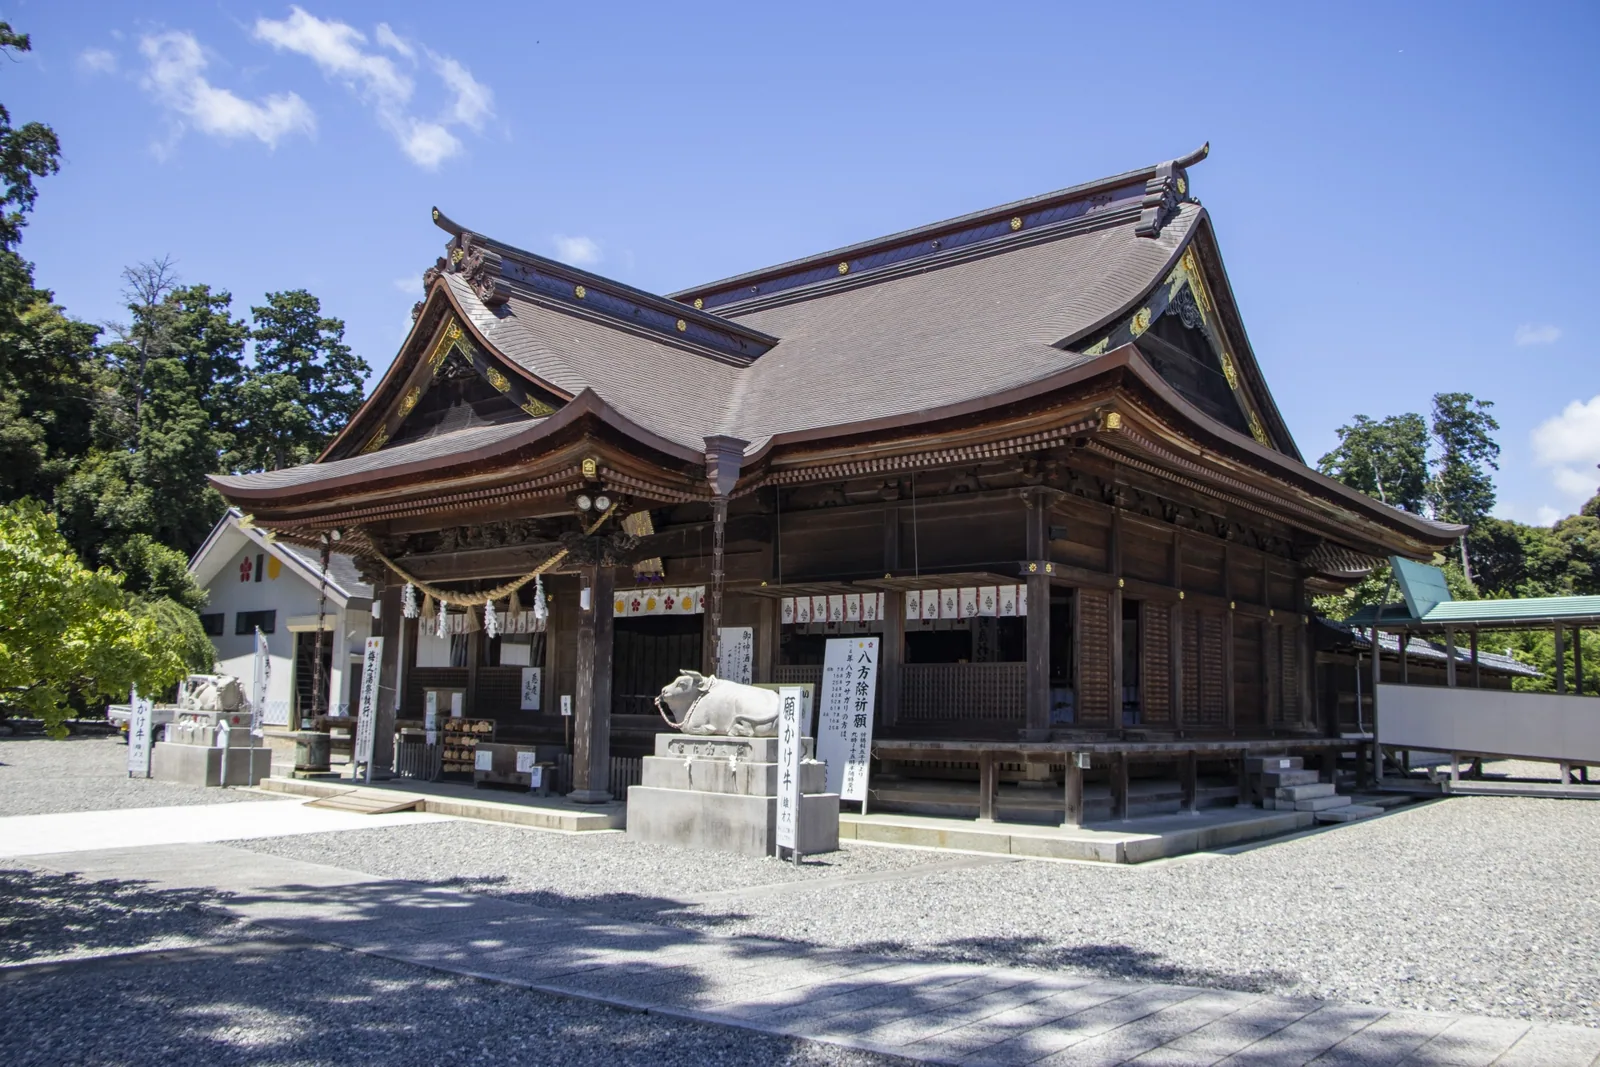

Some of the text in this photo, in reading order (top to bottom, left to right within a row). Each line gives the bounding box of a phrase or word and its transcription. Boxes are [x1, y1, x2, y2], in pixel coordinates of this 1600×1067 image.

[853, 650, 872, 729] 八方除祈願
[783, 696, 796, 791] 願かけ牛
